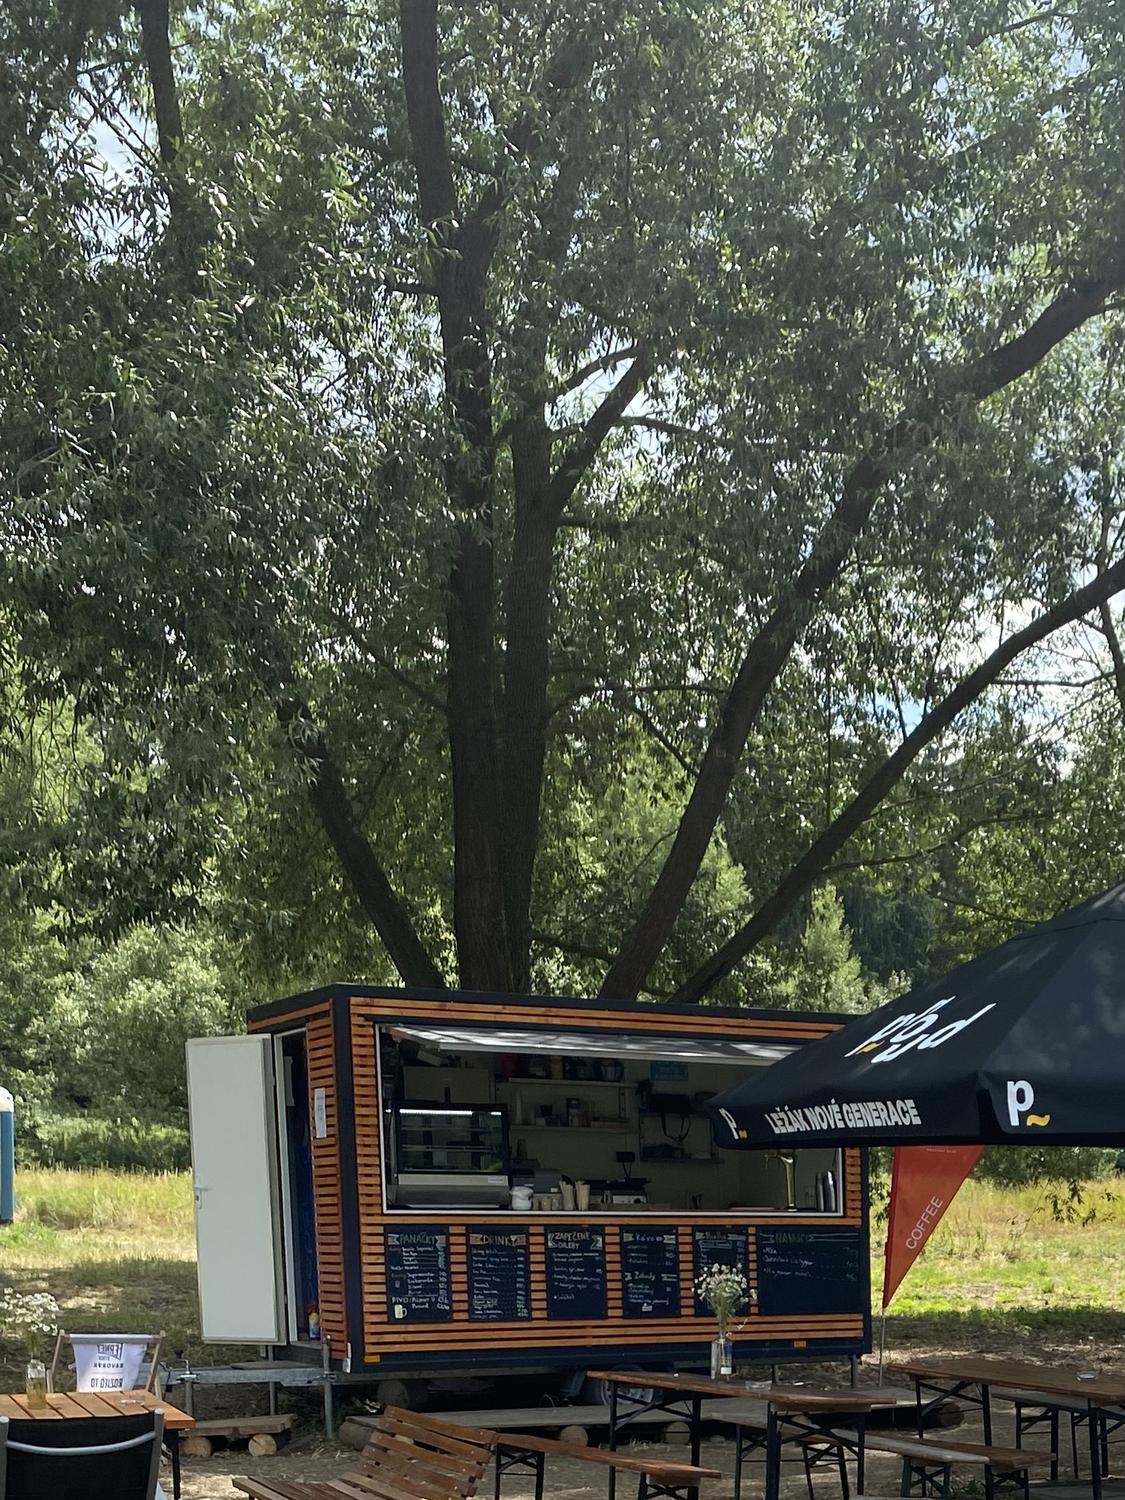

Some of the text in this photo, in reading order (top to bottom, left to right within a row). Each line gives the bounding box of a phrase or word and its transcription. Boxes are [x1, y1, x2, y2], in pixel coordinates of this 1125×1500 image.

[765, 1098, 922, 1134] LEŽÁK NOVÉ GENERACE
[905, 1196, 943, 1249] COFFEE
